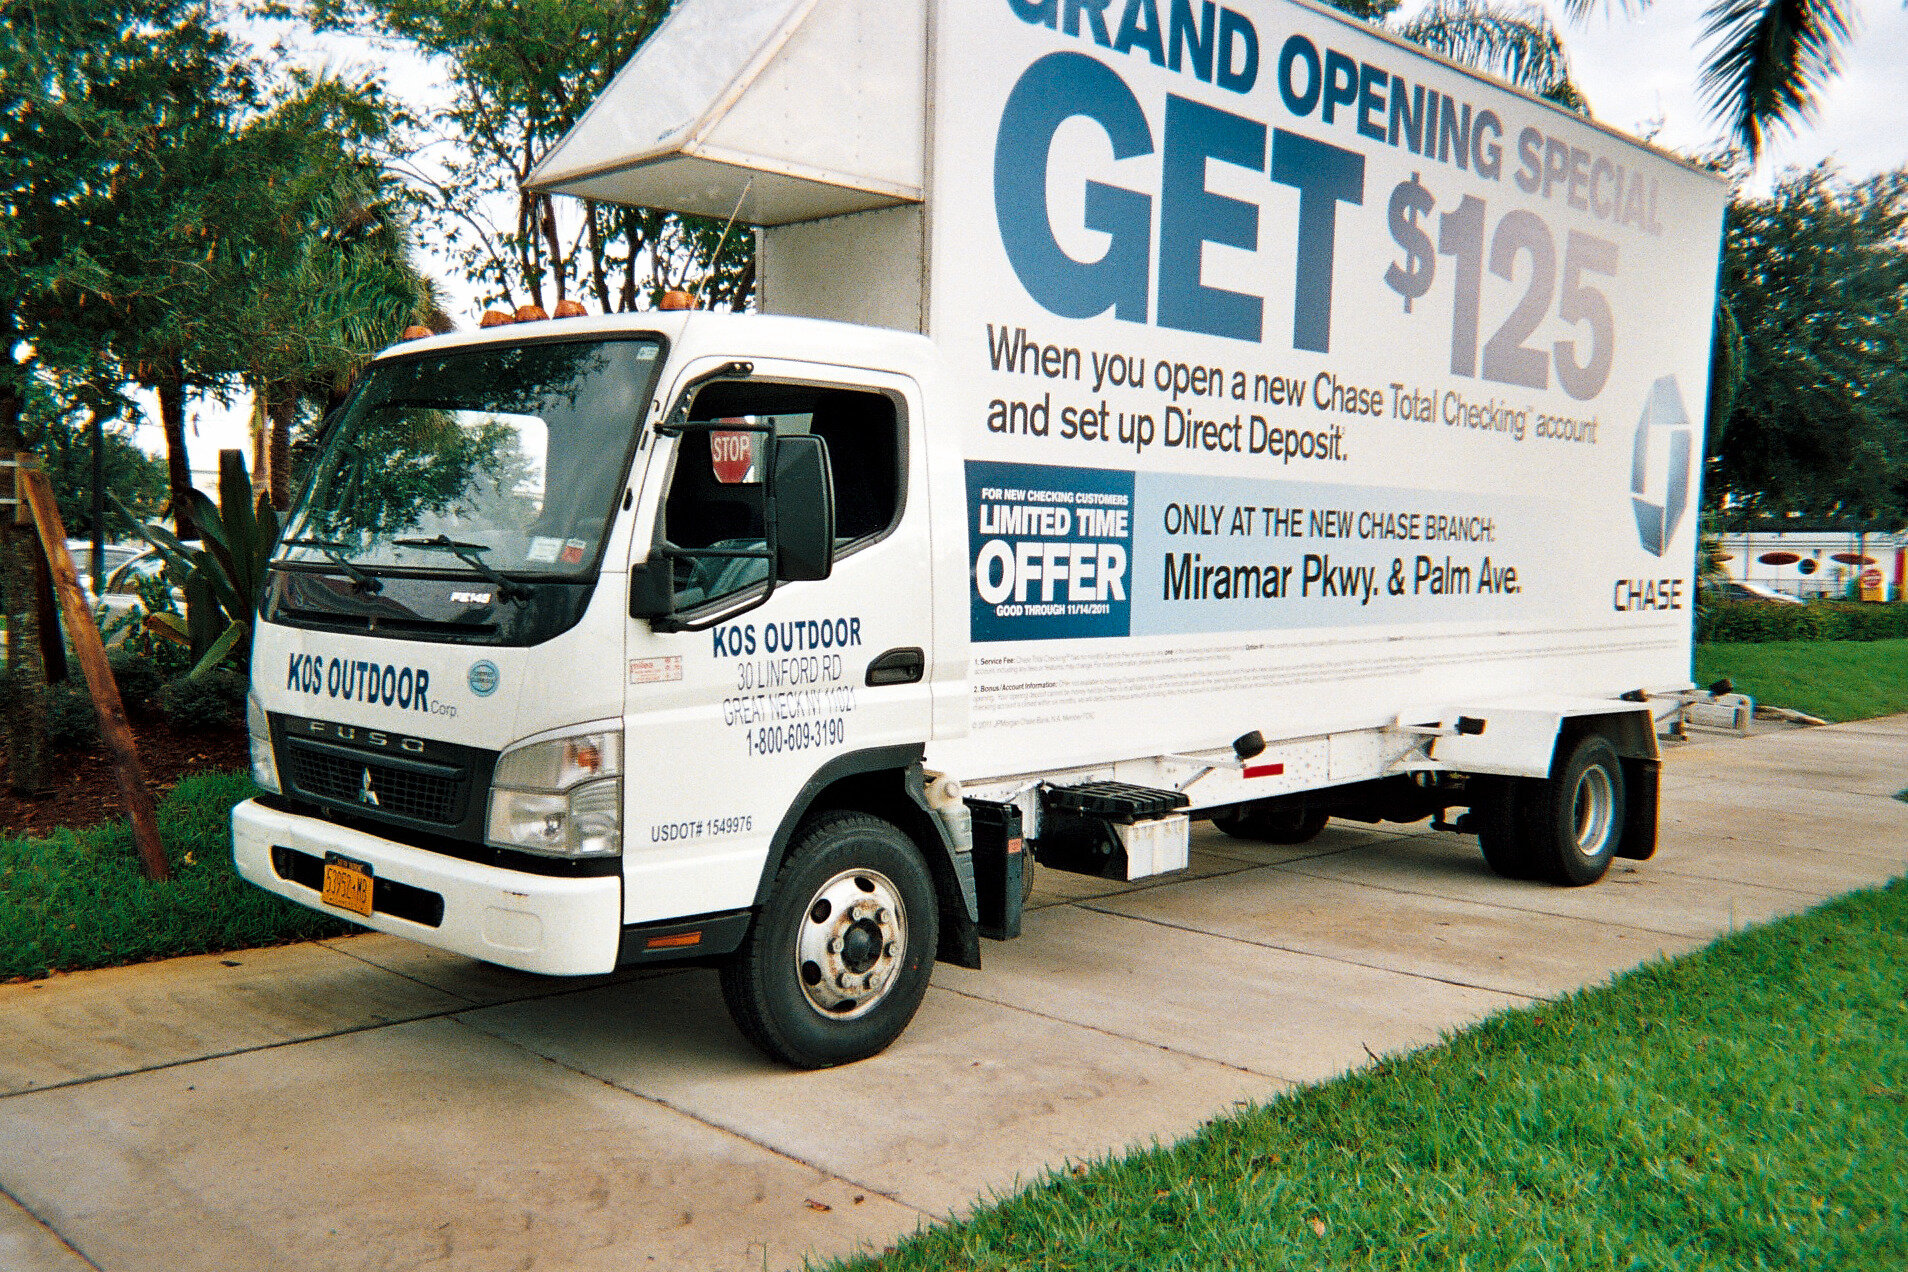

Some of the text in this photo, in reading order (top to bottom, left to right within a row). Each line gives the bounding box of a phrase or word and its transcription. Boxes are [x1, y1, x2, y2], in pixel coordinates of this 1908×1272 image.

[1278, 34, 1503, 181] OPENING
[1514, 126, 1663, 237] SPECIAL
[993, 50, 1619, 401] GET $125
[986, 323, 1081, 381] When
[1091, 351, 1145, 393] you
[1154, 360, 1223, 401] open
[1231, 370, 1246, 400] a
[1254, 373, 1306, 407] new
[1313, 371, 1384, 417] Chase
[1389, 382, 1438, 424] Total
[1535, 412, 1598, 445] account
[987, 392, 1050, 437] and
[1060, 400, 1110, 441] set
[1118, 412, 1154, 454] up
[1164, 405, 1243, 453] Direct
[713, 435, 750, 462] STOP
[981, 487, 1129, 506] FOR NEW CHECKING CUSTOMERS
[979, 504, 1129, 538] LIMITED TIME
[1164, 502, 1497, 542] ONLY AT THE NEW CHASE BRANCH:
[976, 539, 1127, 605] OFFER
[1163, 552, 1522, 606] Miramar Pkwy. & Palm Ave.
[996, 602, 1110, 617] GOOD THROUGH 11/14/2011
[1613, 578, 1684, 612] CHASE
[712, 617, 862, 658] KOS OUTDOOR
[737, 653, 842, 691] 30 LINFORD RD
[980, 656, 1003, 666] Service
[287, 652, 323, 696] KOS
[328, 656, 429, 713] OUTDOOR
[723, 694, 765, 727] GREAT
[768, 690, 806, 720] NECK
[806, 688, 822, 716] NY
[309, 721, 425, 753] FUSO
[746, 717, 844, 757] 1-800-609-3190
[651, 815, 752, 843] USDOT# 1549976
